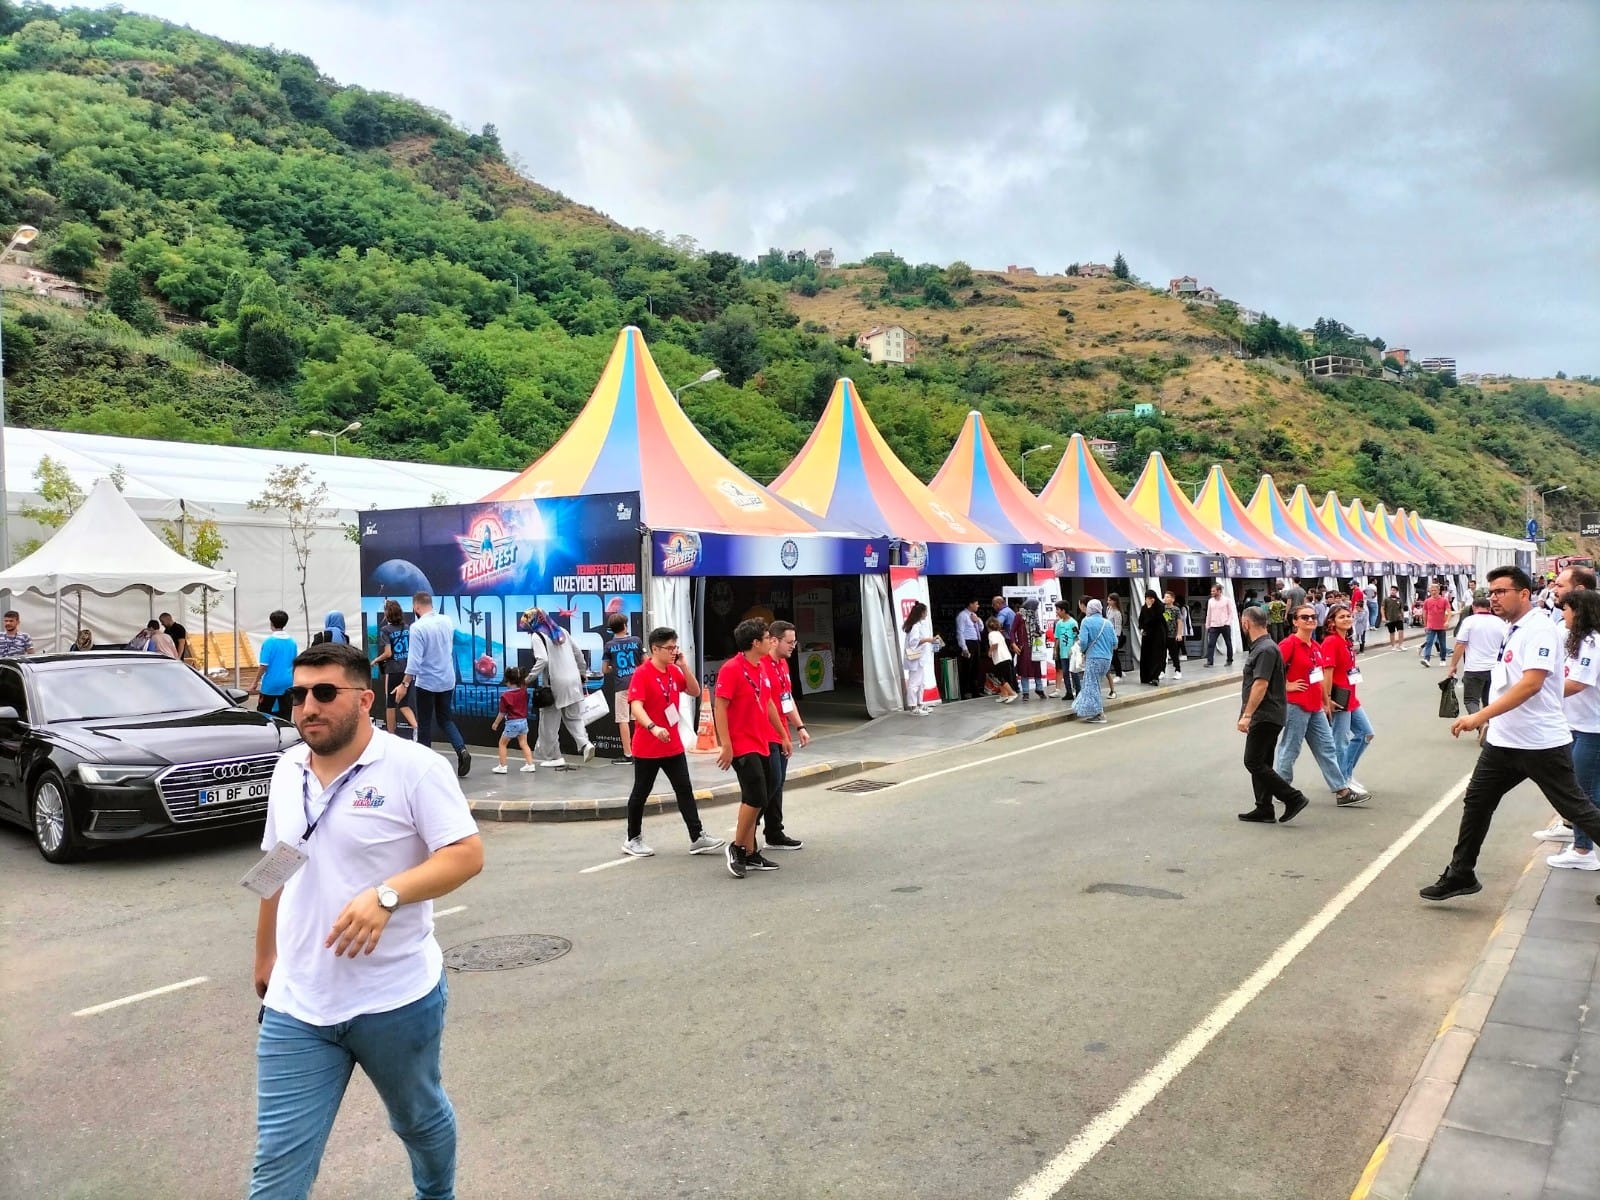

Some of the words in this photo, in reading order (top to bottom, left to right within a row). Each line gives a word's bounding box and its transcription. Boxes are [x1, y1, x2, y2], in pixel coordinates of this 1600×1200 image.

[461, 545, 518, 582] TEKNOFEST
[553, 575, 598, 592] KUZEYDEN
[616, 650, 635, 668] 61
[206, 791, 220, 803] 61
[226, 788, 241, 800] BF
[248, 784, 268, 797] 001
